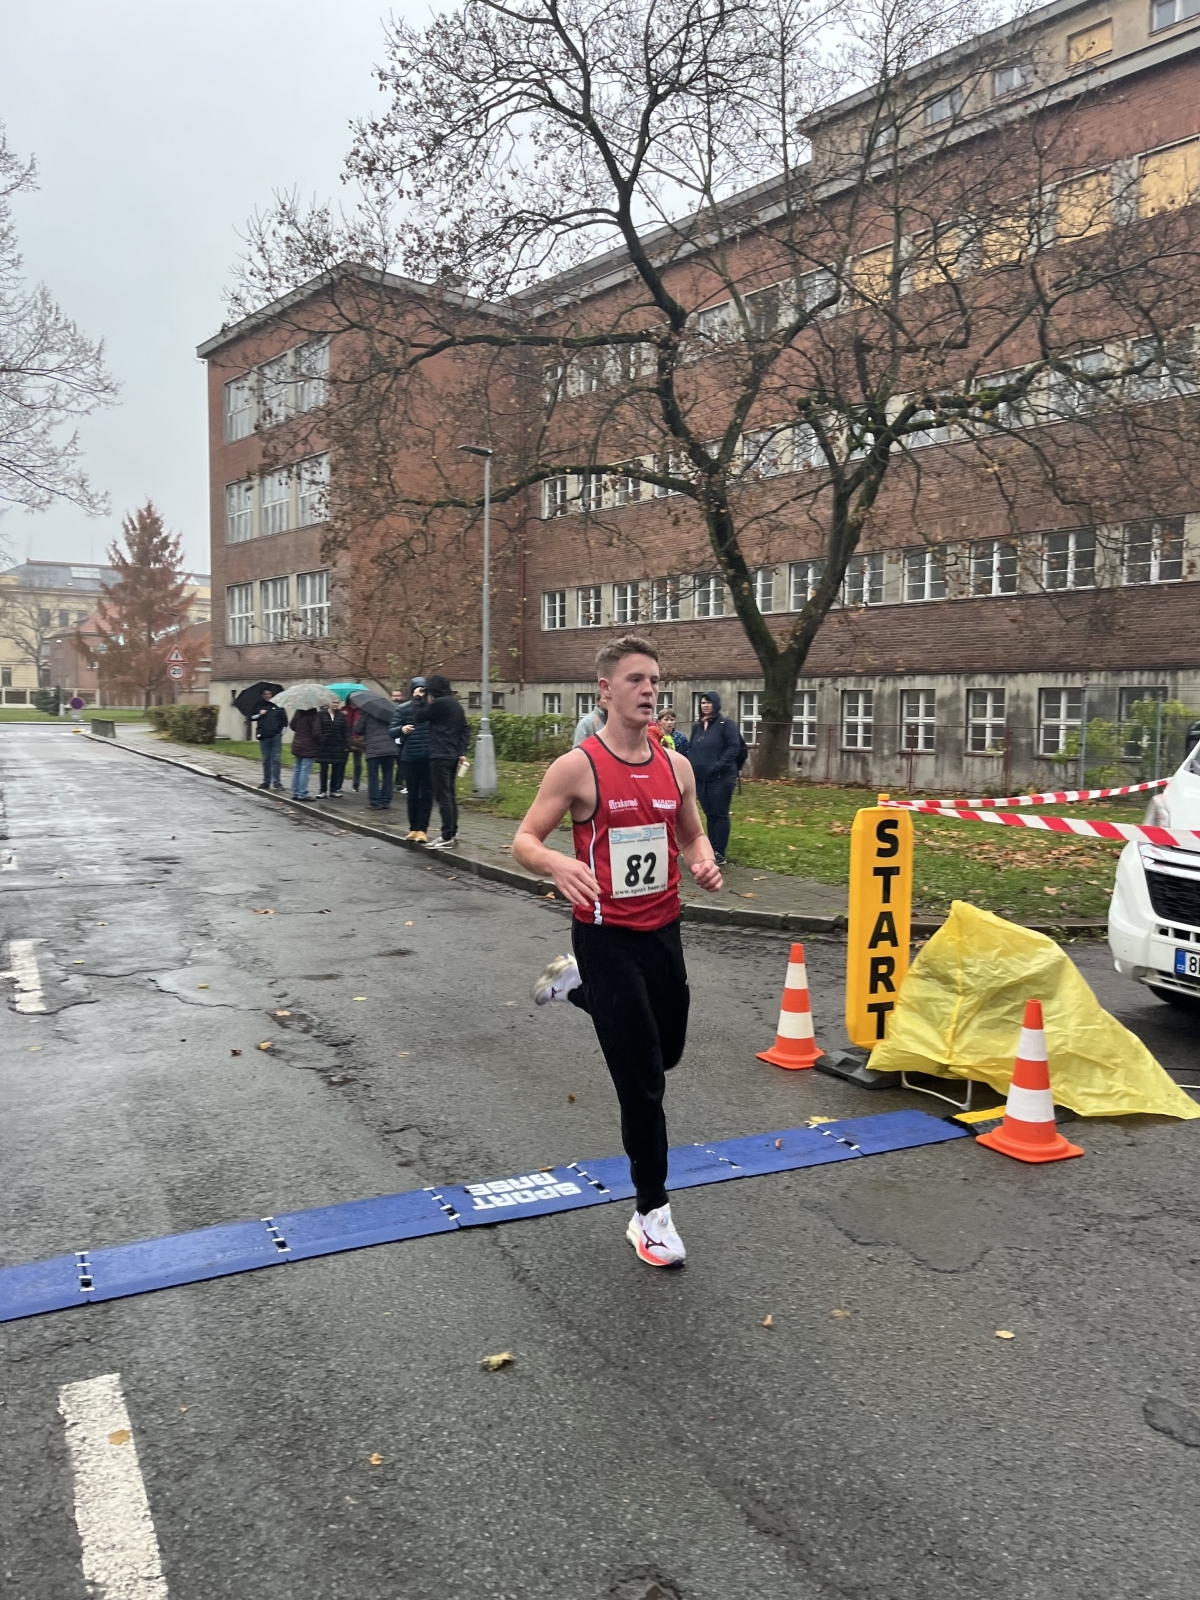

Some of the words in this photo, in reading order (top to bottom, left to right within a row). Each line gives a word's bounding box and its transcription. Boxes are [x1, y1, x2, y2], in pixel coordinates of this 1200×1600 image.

[171, 667, 182, 675] 20
[625, 852, 657, 888] 82
[867, 819, 900, 1040] START
[1189, 956, 1200, 975] 8
[464, 1172, 558, 1196] BASE
[472, 1182, 582, 1211] SPORT
